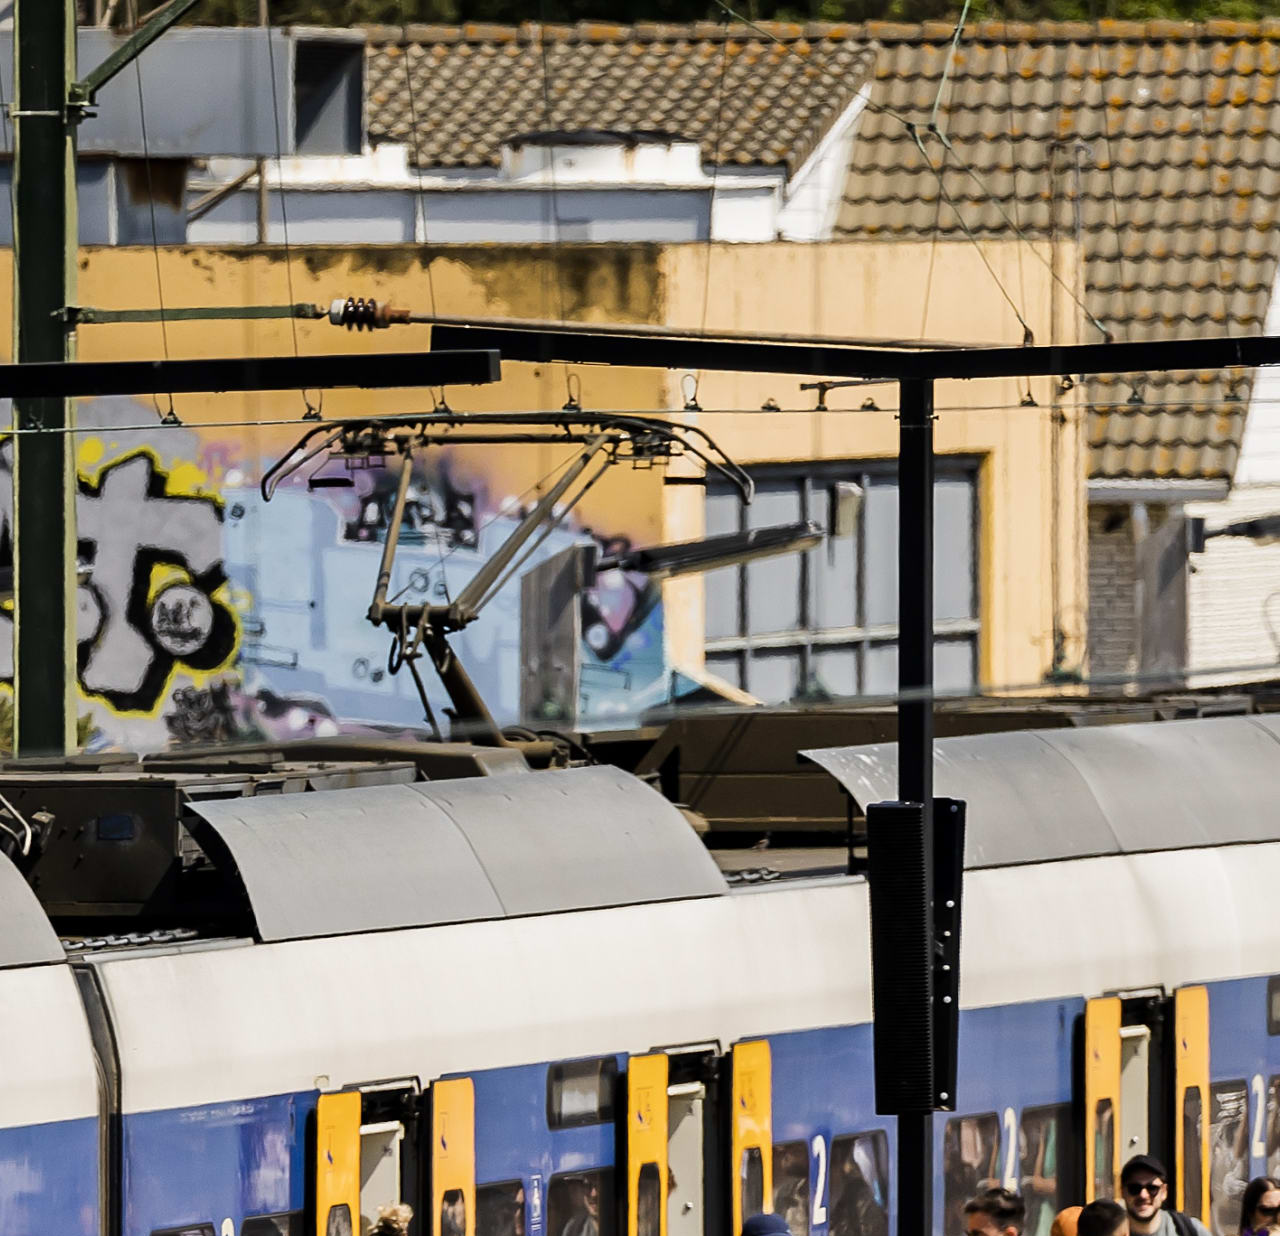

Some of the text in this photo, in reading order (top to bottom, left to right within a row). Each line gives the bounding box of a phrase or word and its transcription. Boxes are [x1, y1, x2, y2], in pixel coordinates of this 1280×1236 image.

[1003, 1106, 1018, 1192] 2
[1251, 1073, 1265, 1158] 2
[811, 1134, 826, 1225] 2
